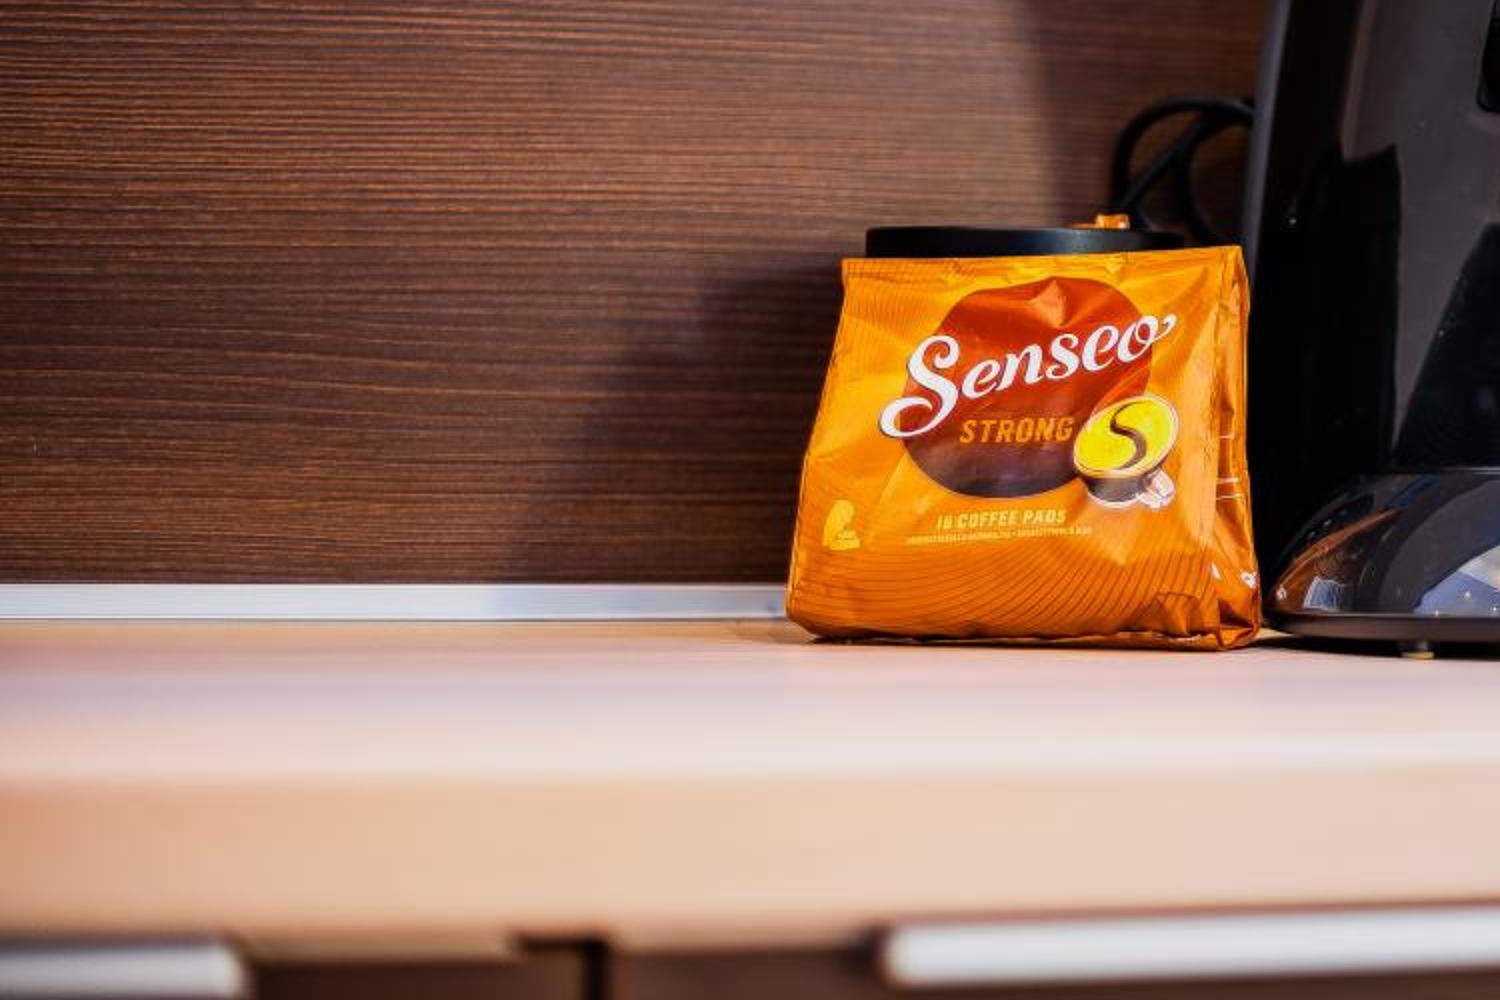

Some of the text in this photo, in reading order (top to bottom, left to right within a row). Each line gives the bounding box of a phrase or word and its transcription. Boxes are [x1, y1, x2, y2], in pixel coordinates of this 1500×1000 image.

[879, 313, 1177, 438] Senseo
[959, 417, 1075, 444] STRONG
[957, 510, 1019, 529] COFFEE
[1022, 508, 1067, 525] PADS
